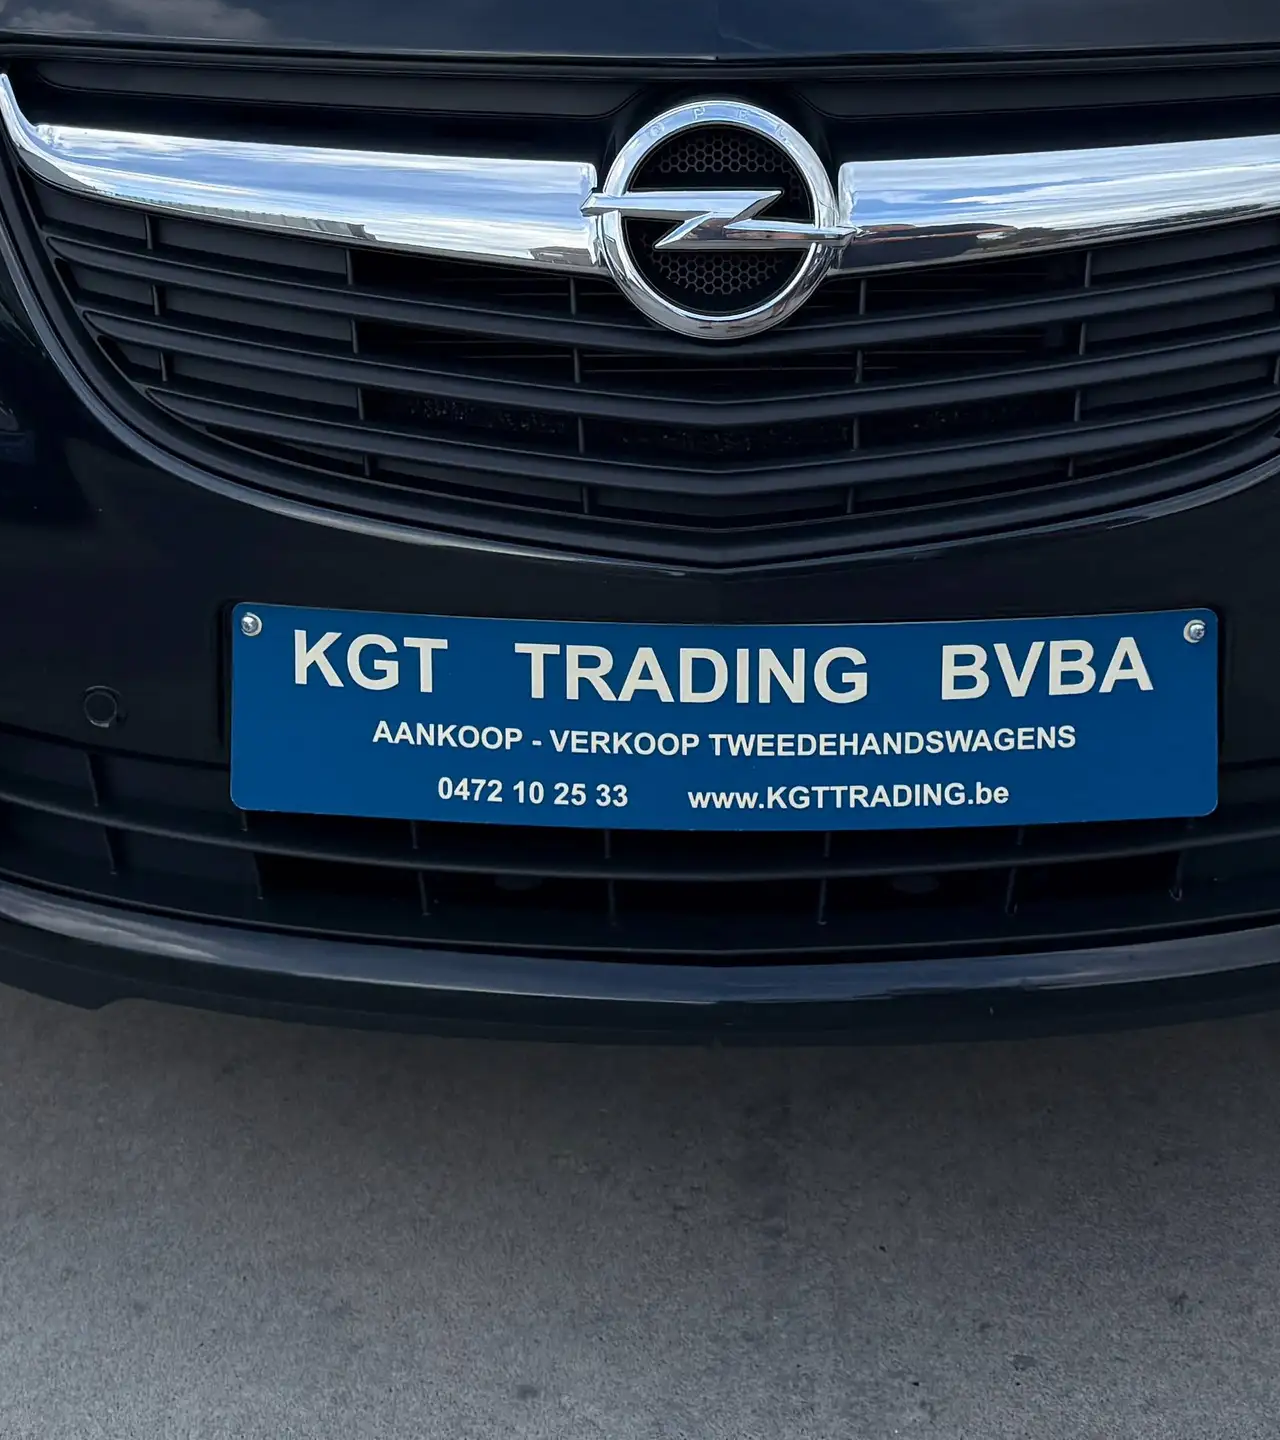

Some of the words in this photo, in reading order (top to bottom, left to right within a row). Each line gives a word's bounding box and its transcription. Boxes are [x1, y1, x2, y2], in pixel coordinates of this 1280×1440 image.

[646, 105, 790, 142] OPEL
[294, 628, 449, 693] KGT
[514, 642, 869, 705] TRADING
[940, 636, 1155, 701] BVBA
[372, 719, 523, 751] AANKOOP
[549, 728, 701, 757] VERKOOP
[708, 725, 1077, 758] TWEEDEHANDSWAGENS
[437, 776, 504, 803] 0472
[513, 780, 546, 805] 10
[553, 782, 588, 807] 25
[595, 783, 629, 808] 33
[687, 781, 1010, 810] www.KGTTRADING.be
